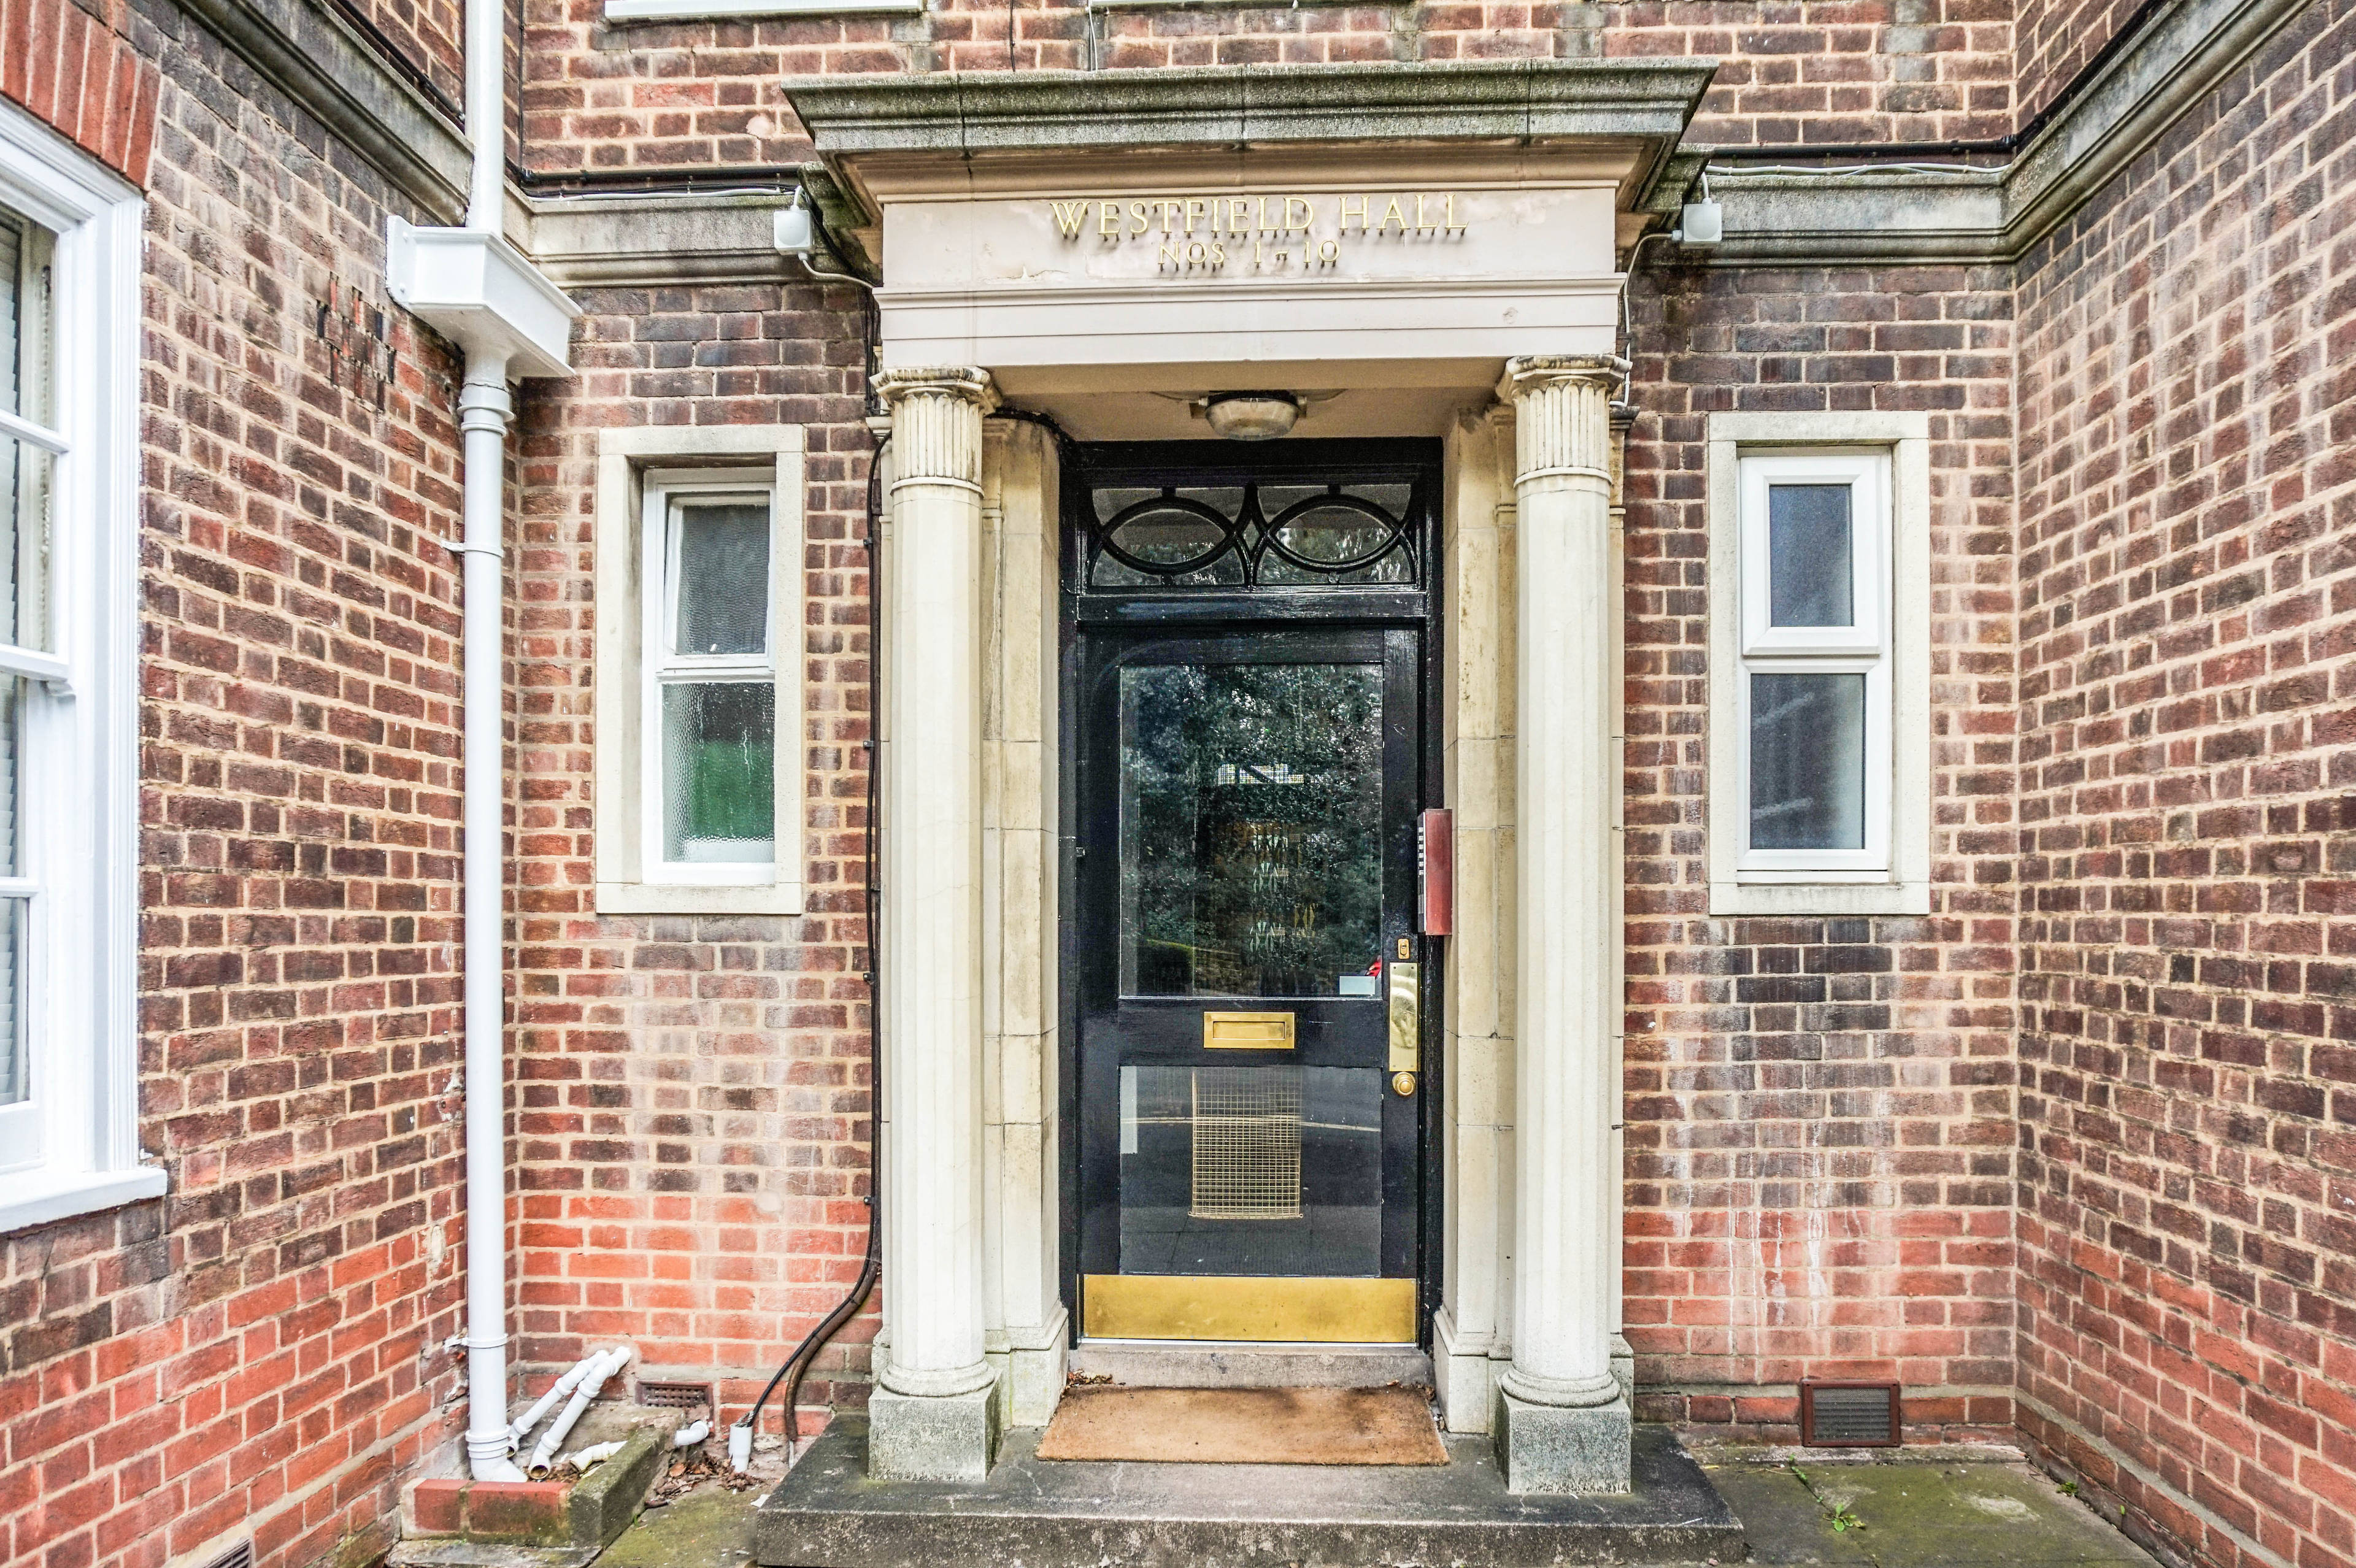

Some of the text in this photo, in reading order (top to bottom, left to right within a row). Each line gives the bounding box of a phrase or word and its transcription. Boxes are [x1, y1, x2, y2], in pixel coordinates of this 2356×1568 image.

[1049, 194, 1469, 236] WESTFIELD HALL
[1157, 240, 1225, 265] NOS
